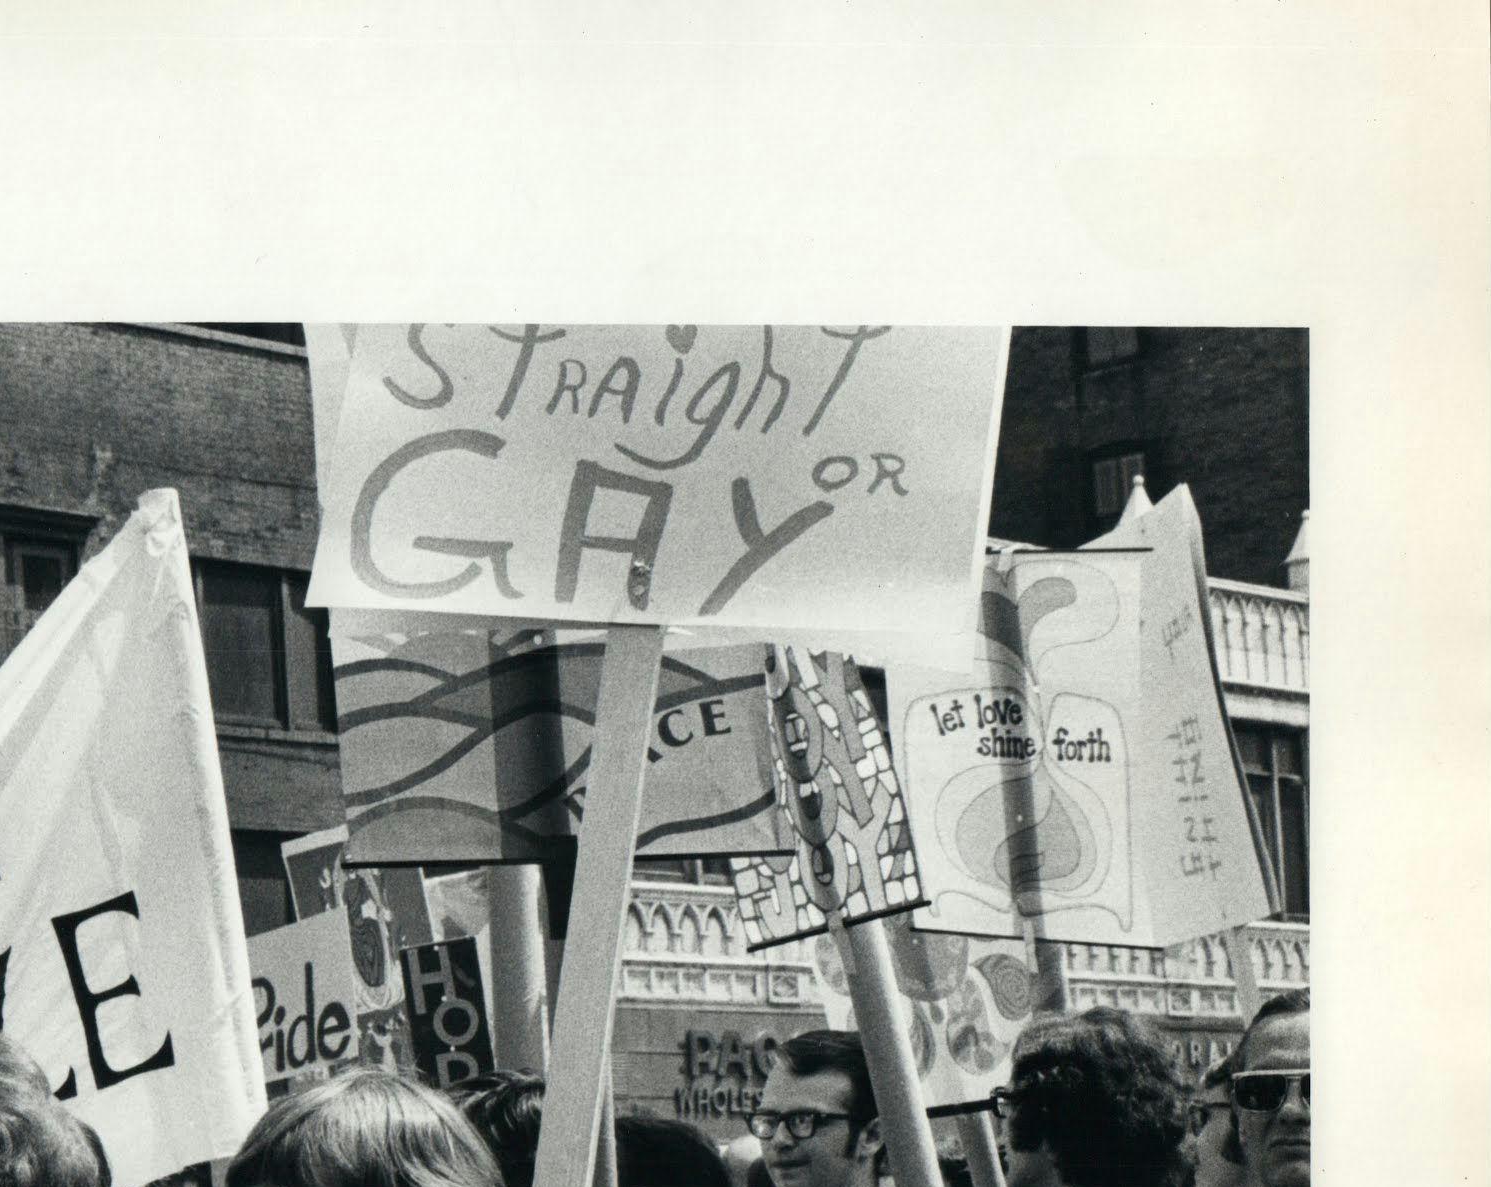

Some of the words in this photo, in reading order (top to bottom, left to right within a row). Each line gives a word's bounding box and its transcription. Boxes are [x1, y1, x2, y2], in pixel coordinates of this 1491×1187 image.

[351, 428, 834, 617] GAY
[811, 452, 909, 496] OR
[929, 699, 966, 737] let
[973, 693, 1024, 729] love
[976, 727, 1037, 760] shine
[1051, 726, 1112, 763] forth
